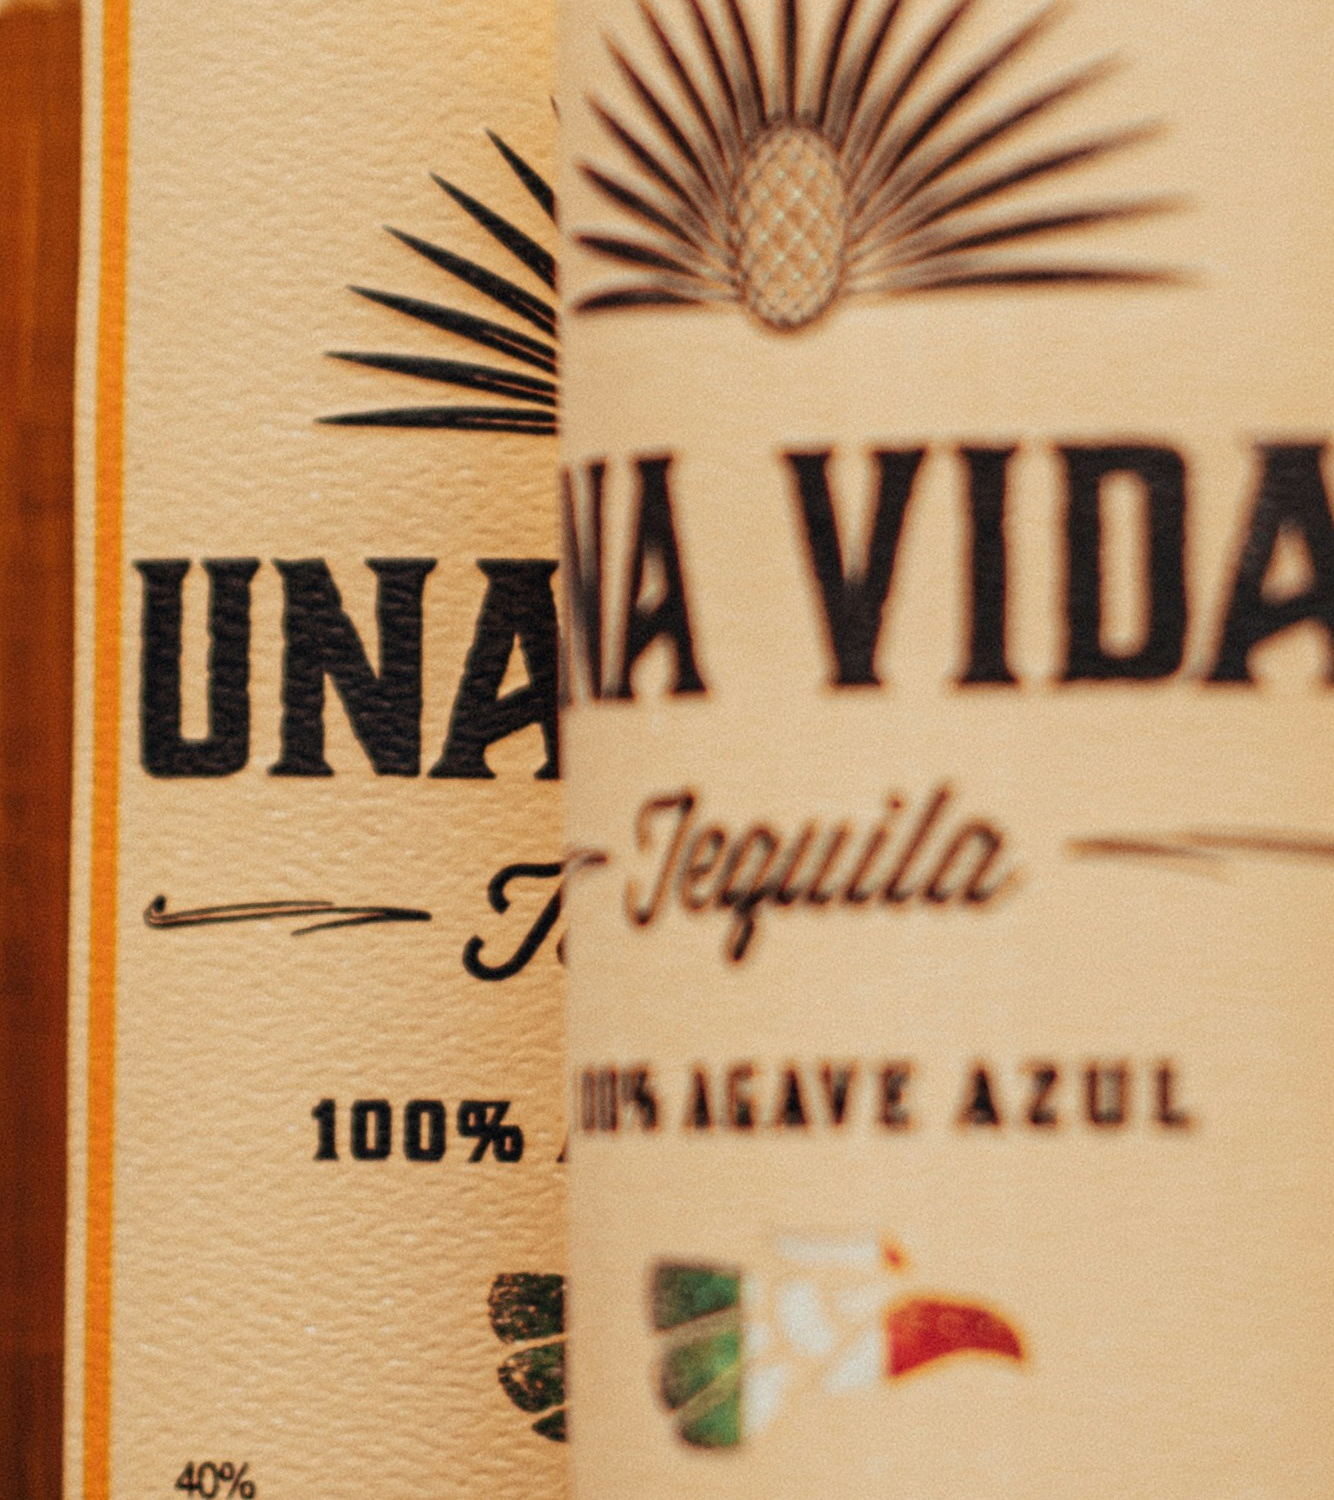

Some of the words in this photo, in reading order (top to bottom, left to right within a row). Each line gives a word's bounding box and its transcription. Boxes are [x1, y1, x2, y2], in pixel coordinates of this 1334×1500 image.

[132, 556, 560, 782] UNA
[620, 785, 1019, 965] Tequila
[312, 1099, 524, 1164] 100%
[685, 1060, 919, 1132] AGAVE
[959, 1058, 1193, 1130] AZUL
[174, 1460, 257, 1500] 40%
